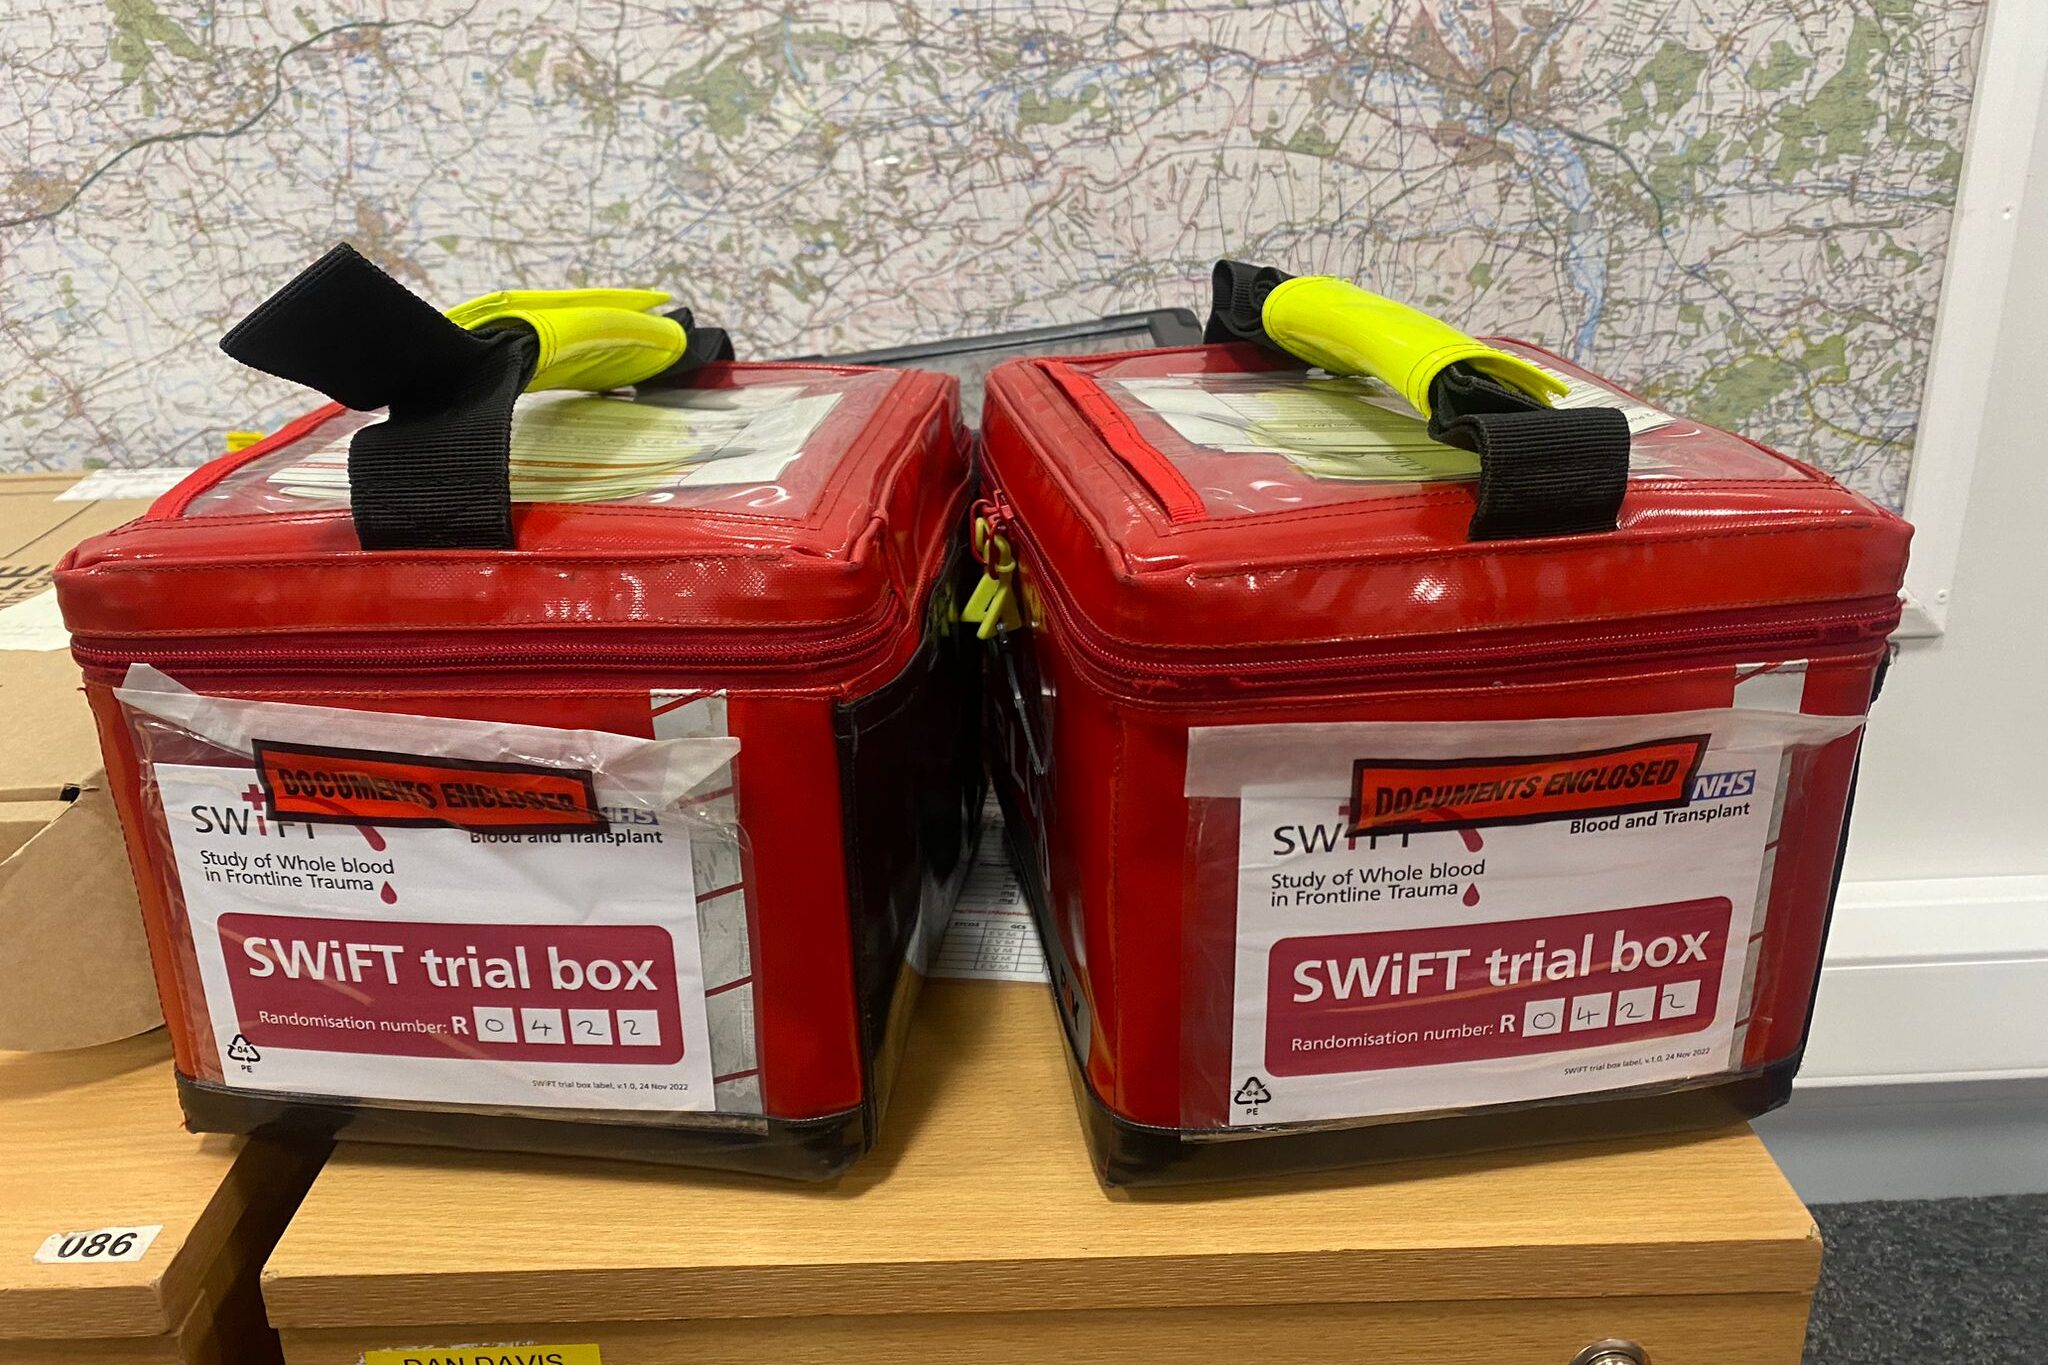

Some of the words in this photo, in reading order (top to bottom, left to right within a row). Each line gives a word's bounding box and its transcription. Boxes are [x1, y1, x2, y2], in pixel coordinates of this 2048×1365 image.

[276, 767, 437, 810] DOCUMENTS
[440, 783, 578, 812] ENCLOSED
[1375, 776, 1541, 817] DOCUMENTS
[1544, 759, 1680, 797] ENCLOSED
[1692, 771, 1752, 799] NHS
[1570, 816, 1620, 834] Blood
[1625, 812, 1658, 829] and
[1663, 802, 1750, 824] Transplant
[528, 833, 562, 844] and
[200, 850, 248, 870] Study
[254, 853, 272, 869] of
[276, 855, 337, 872] Whole
[342, 858, 395, 875] blood
[1271, 871, 1327, 891] Study
[1332, 869, 1354, 886] of
[1359, 865, 1424, 884] Whole
[1430, 859, 1486, 880] blood
[204, 867, 222, 882] in
[227, 869, 303, 888] Frontline
[306, 874, 374, 891] Trauma
[1271, 890, 1289, 907] in
[1295, 886, 1381, 907] Frontline
[1387, 883, 1458, 900] Trauma
[243, 936, 405, 985] SWiFT
[420, 945, 531, 989] trial
[547, 946, 658, 990] box
[1293, 949, 1471, 1003] SWiFT
[1485, 933, 1594, 987] trial
[1610, 930, 1710, 974] box
[259, 1010, 376, 1031] Randomisation
[380, 1018, 448, 1034] number:
[451, 1015, 469, 1035] R
[1292, 1031, 1418, 1051] Randomisation
[1423, 1023, 1494, 1042] number:
[1500, 1014, 1516, 1034] R
[241, 1064, 253, 1073] PE
[1589, 1063, 1605, 1073] trial
[1606, 1061, 1622, 1070] box
[1665, 1052, 1676, 1061] 24
[1676, 1050, 1692, 1059] Nov
[1692, 1047, 1711, 1057] 2022
[558, 1080, 574, 1089] trial
[575, 1081, 591, 1089] box
[639, 1083, 650, 1091] 24
[651, 1083, 668, 1091] Nov
[669, 1083, 688, 1091] 2022
[1246, 1107, 1259, 1116] PE
[57, 1232, 138, 1258] 086
